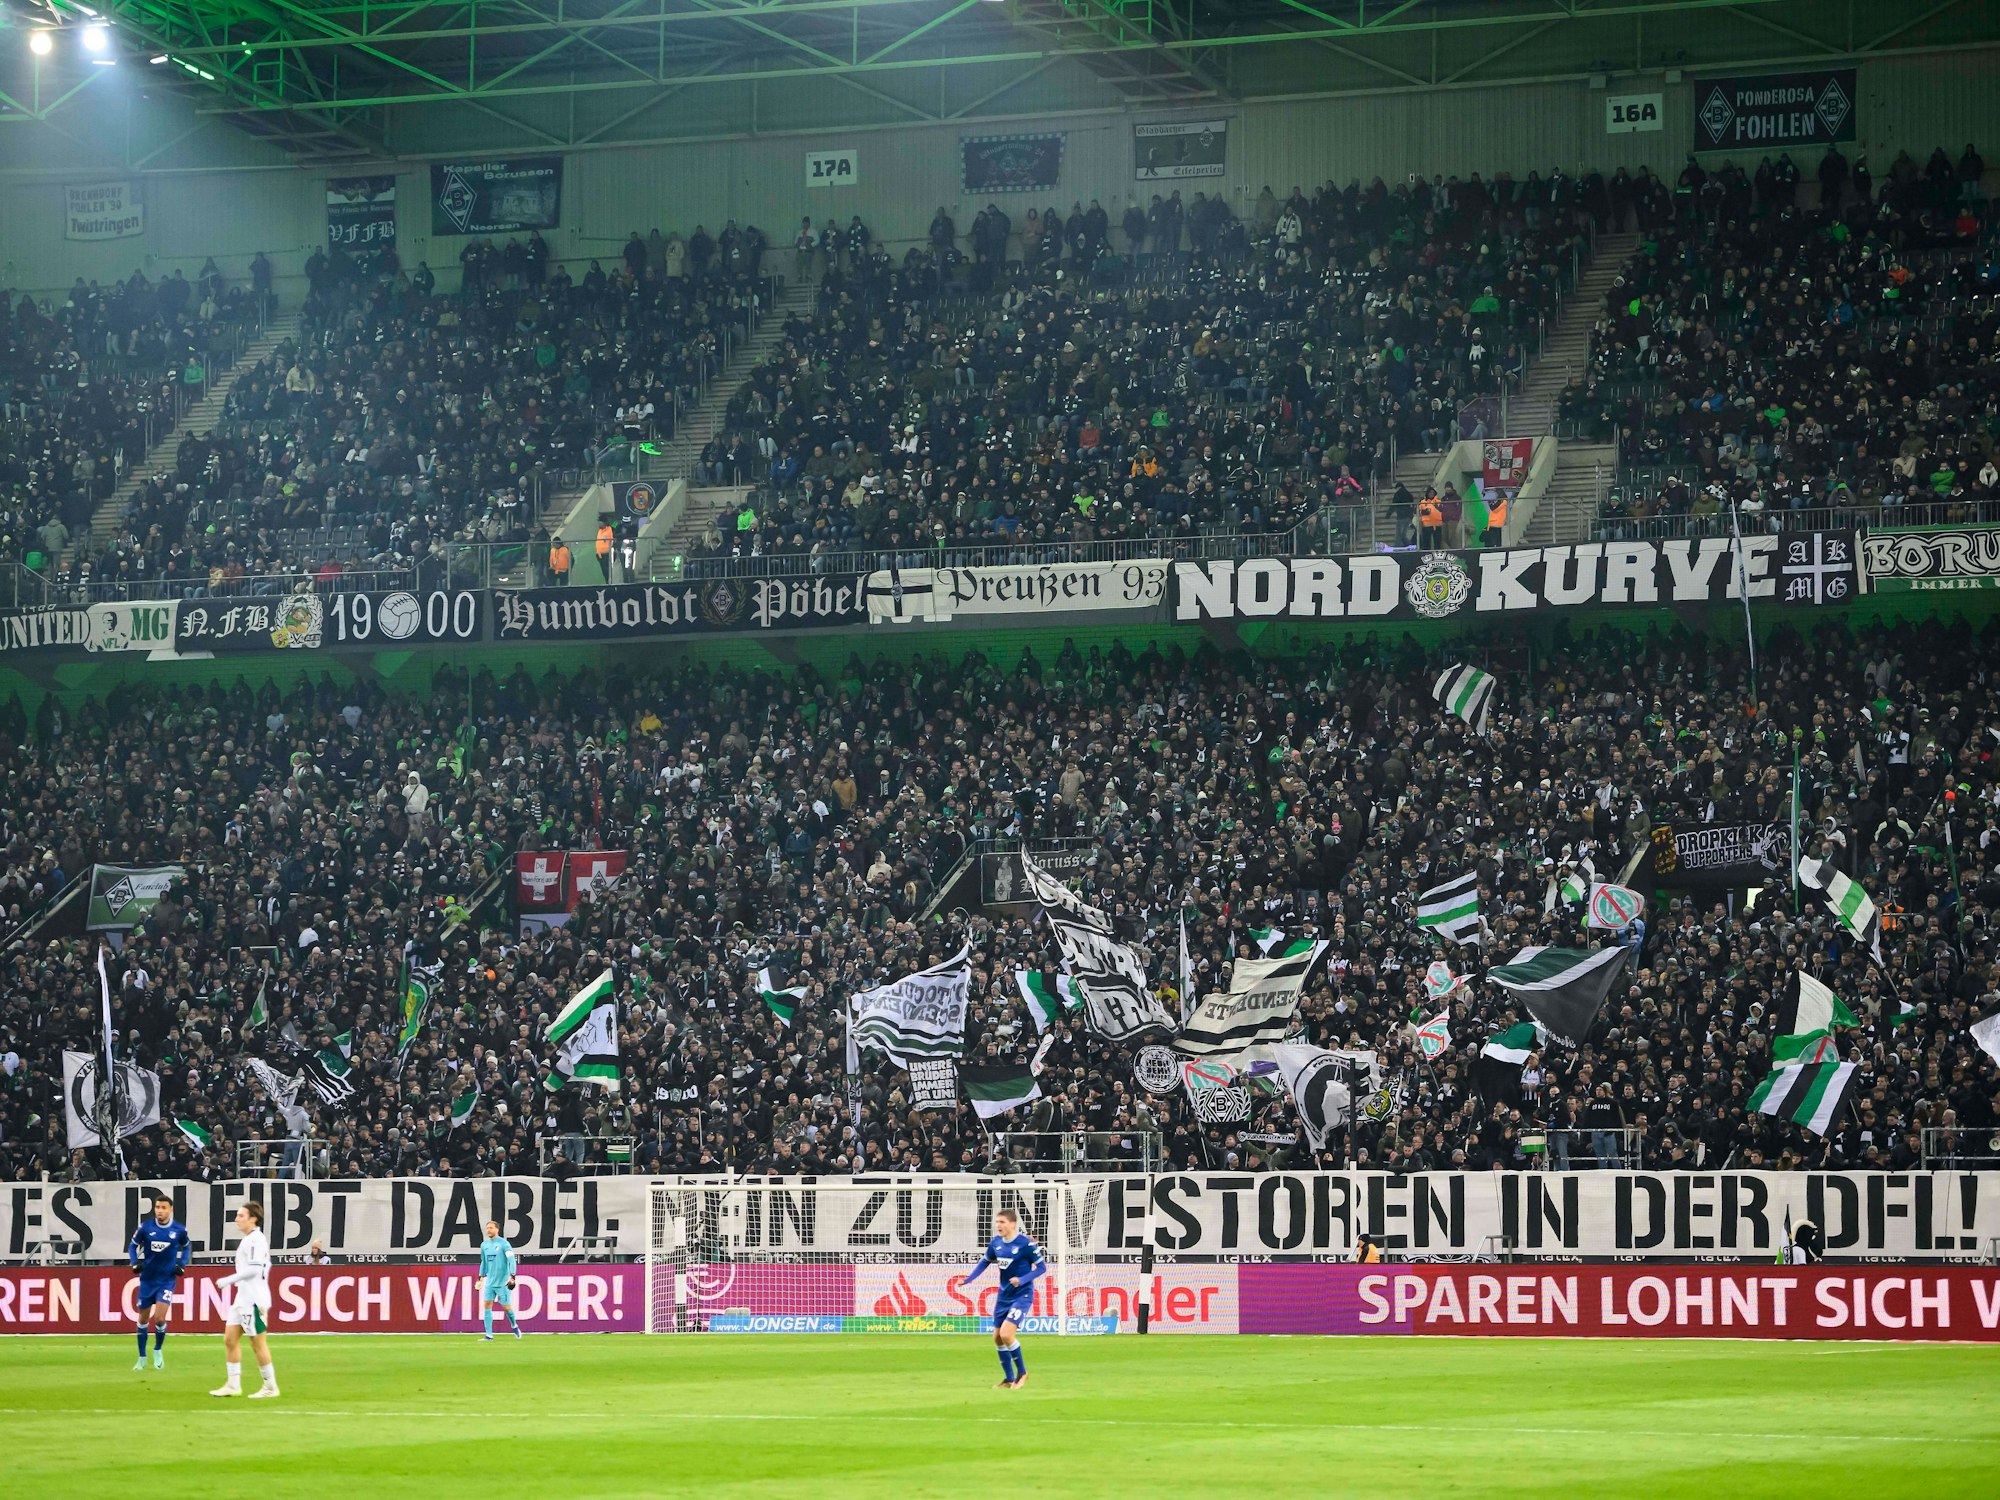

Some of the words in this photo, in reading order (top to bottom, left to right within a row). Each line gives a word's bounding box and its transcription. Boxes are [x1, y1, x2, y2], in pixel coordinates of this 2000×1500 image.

[1736, 86, 1815, 107] PONDEROSA
[1613, 103, 1657, 122] 16A
[1735, 113, 1815, 140] FOHLEN
[443, 163, 507, 174] Kapeller
[484, 168, 553, 180] Borussen
[813, 159, 851, 177] 17A
[938, 567, 1100, 608] Preußen
[1175, 556, 1400, 620] NORD
[1476, 535, 1778, 611] KURVE
[1910, 579, 1981, 590] IMMER
[750, 575, 868, 628] Pöbel
[499, 587, 698, 638] Humboldt
[131, 607, 169, 640] MG
[1684, 843, 1753, 869] SUPPORTERS
[134, 882, 169, 891] Fanclub
[909, 1059, 953, 1071] UNSERE
[912, 1079, 955, 1091] IMMER
[9, 1187, 94, 1255] ES
[848, 1178, 943, 1248] ZU
[977, 1175, 1465, 1250] INVESTOREN
[1502, 1175, 1579, 1249] IN
[1615, 1176, 1770, 1249] DER
[1806, 1175, 1978, 1250] DFL!
[152, 1243, 166, 1251] SAP
[279, 1275, 391, 1323] SICH
[408, 1274, 624, 1322] WILDER!
[1358, 1275, 1579, 1325] SPAREN
[1601, 1276, 1798, 1326] LOHNT
[1815, 1277, 1951, 1328] SICH
[1007, 1307, 1022, 1321] 29
